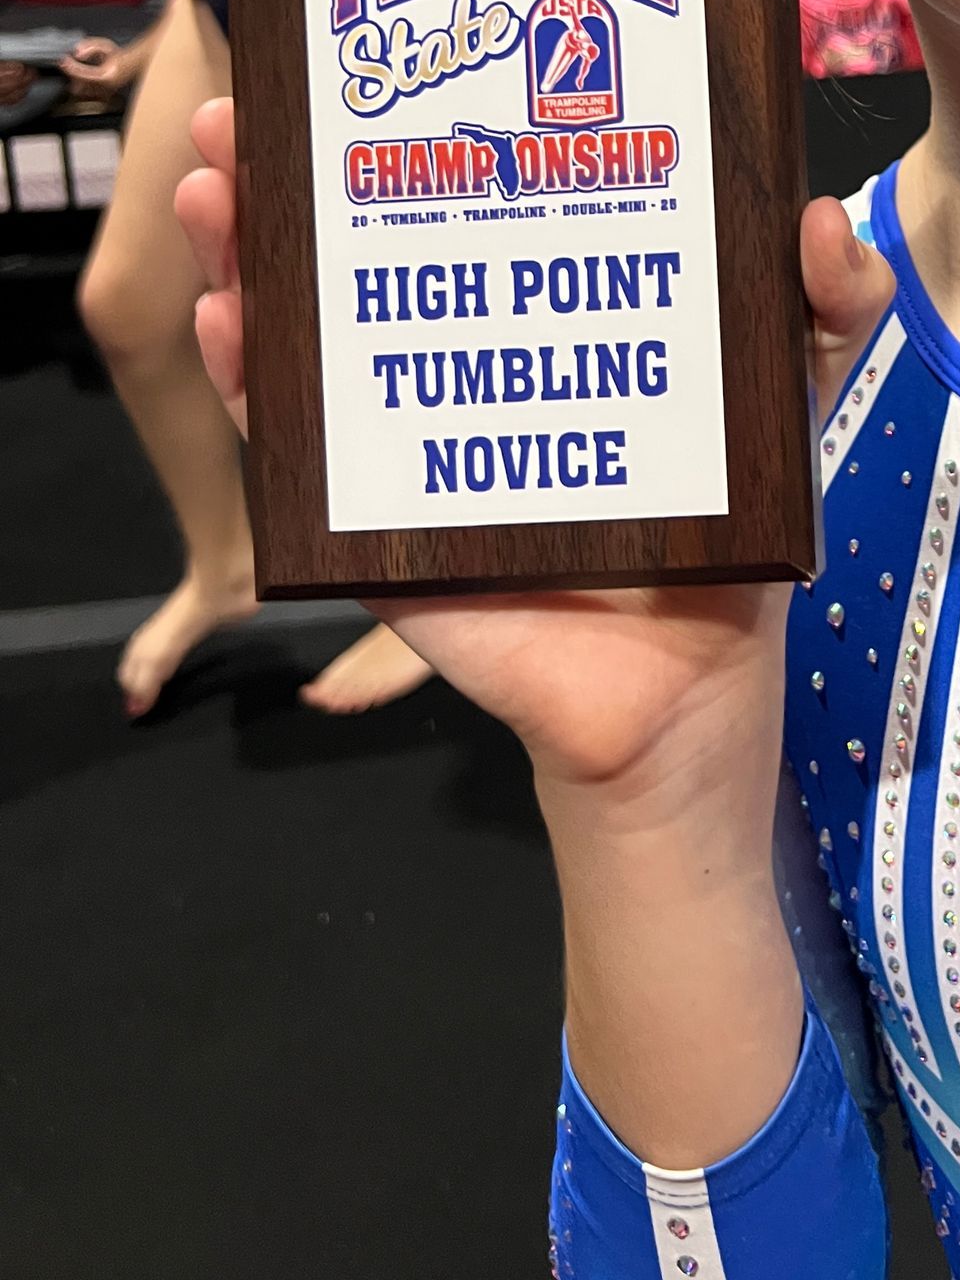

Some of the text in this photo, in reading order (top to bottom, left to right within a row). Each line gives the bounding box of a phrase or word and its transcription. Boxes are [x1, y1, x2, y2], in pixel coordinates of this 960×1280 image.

[543, 95, 607, 108] TRAMPOLINE
[556, 105, 607, 118] TUMBLING
[351, 215, 368, 228] 20
[381, 211, 447, 226] TUMBLING
[463, 206, 546, 222] TRAMPOLINE
[563, 200, 646, 216] DOUBLE-MINI
[354, 252, 681, 323] HIGH POINT
[373, 340, 668, 408] TUMBLING
[423, 430, 627, 494] NOVICE
